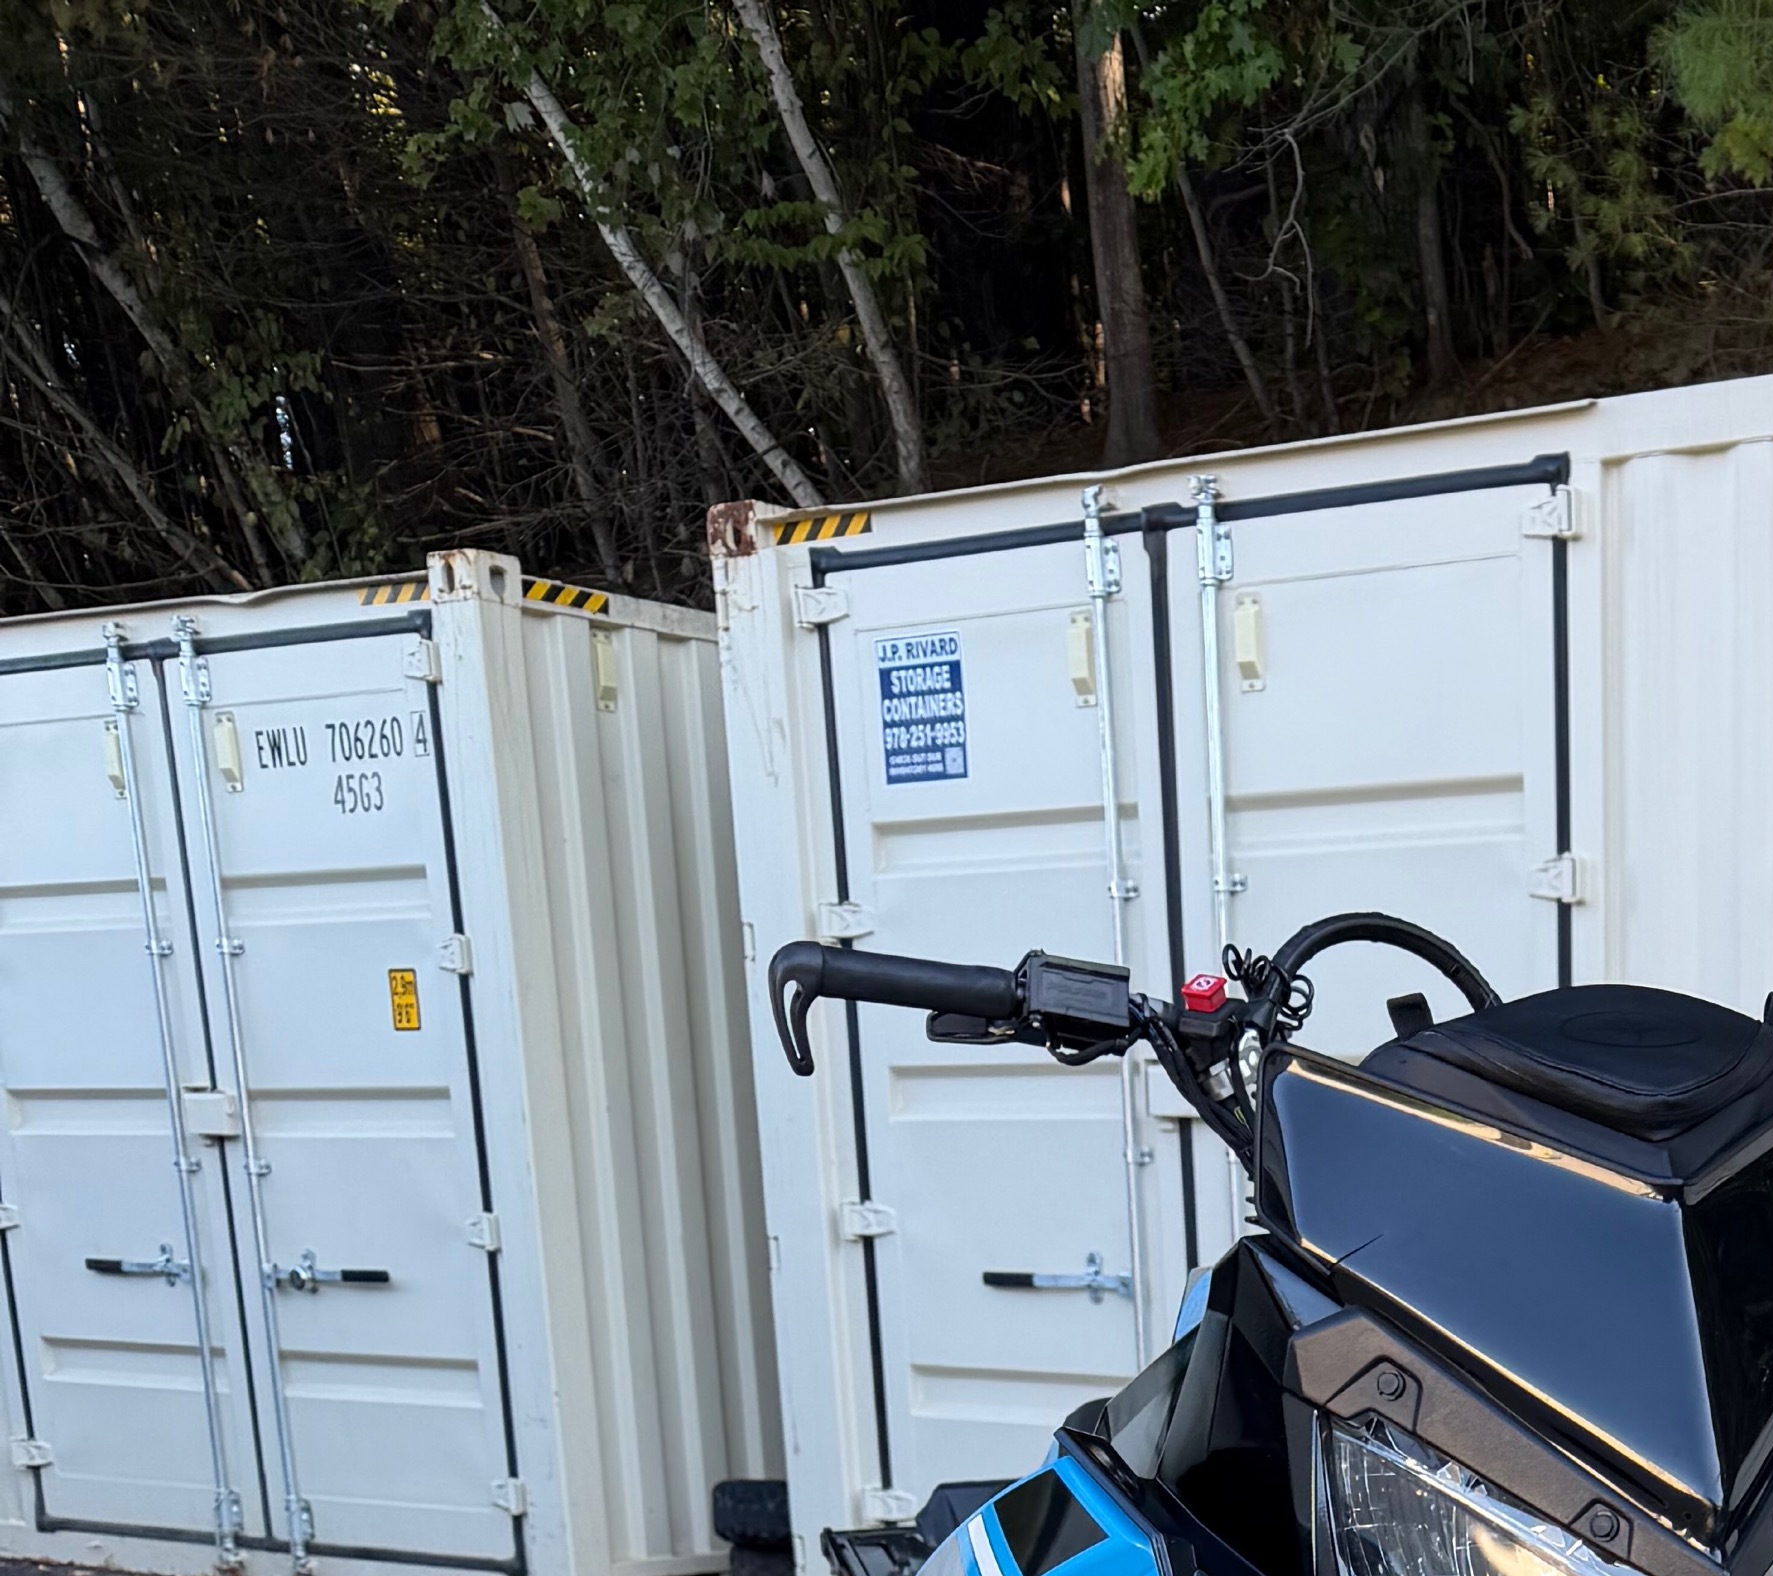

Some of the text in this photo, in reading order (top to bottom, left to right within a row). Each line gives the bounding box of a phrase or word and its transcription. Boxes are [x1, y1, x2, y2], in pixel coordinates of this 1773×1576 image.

[880, 637, 958, 663] J.P. RIVARD
[890, 665, 952, 694] STORAGE
[883, 691, 964, 723] CONTAINERS
[255, 726, 308, 768] EWLU
[325, 716, 404, 762] 706260
[885, 720, 965, 750] 978-251-9953
[334, 772, 384, 814] 45G3
